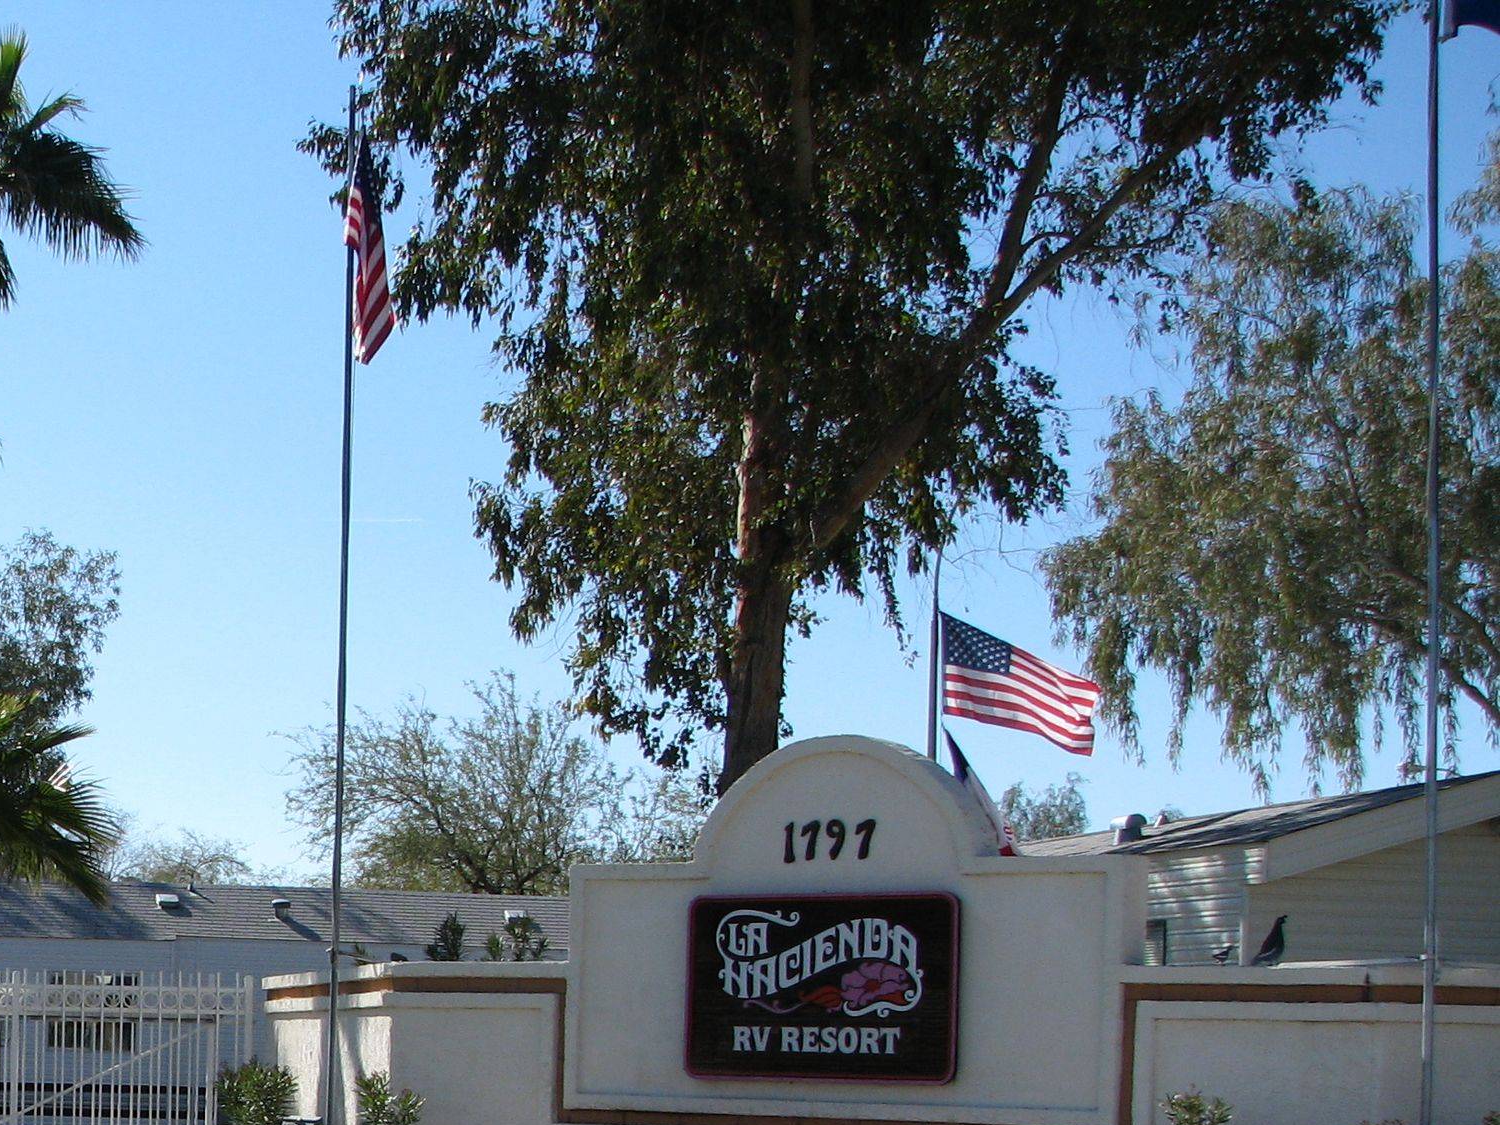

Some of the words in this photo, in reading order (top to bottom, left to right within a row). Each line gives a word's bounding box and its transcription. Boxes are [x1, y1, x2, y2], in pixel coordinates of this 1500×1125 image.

[783, 818, 877, 864] 1797
[718, 917, 924, 999] HACIENDA
[727, 922, 769, 956] LA
[732, 1026, 772, 1052] RV
[781, 1026, 900, 1055] RESORT
